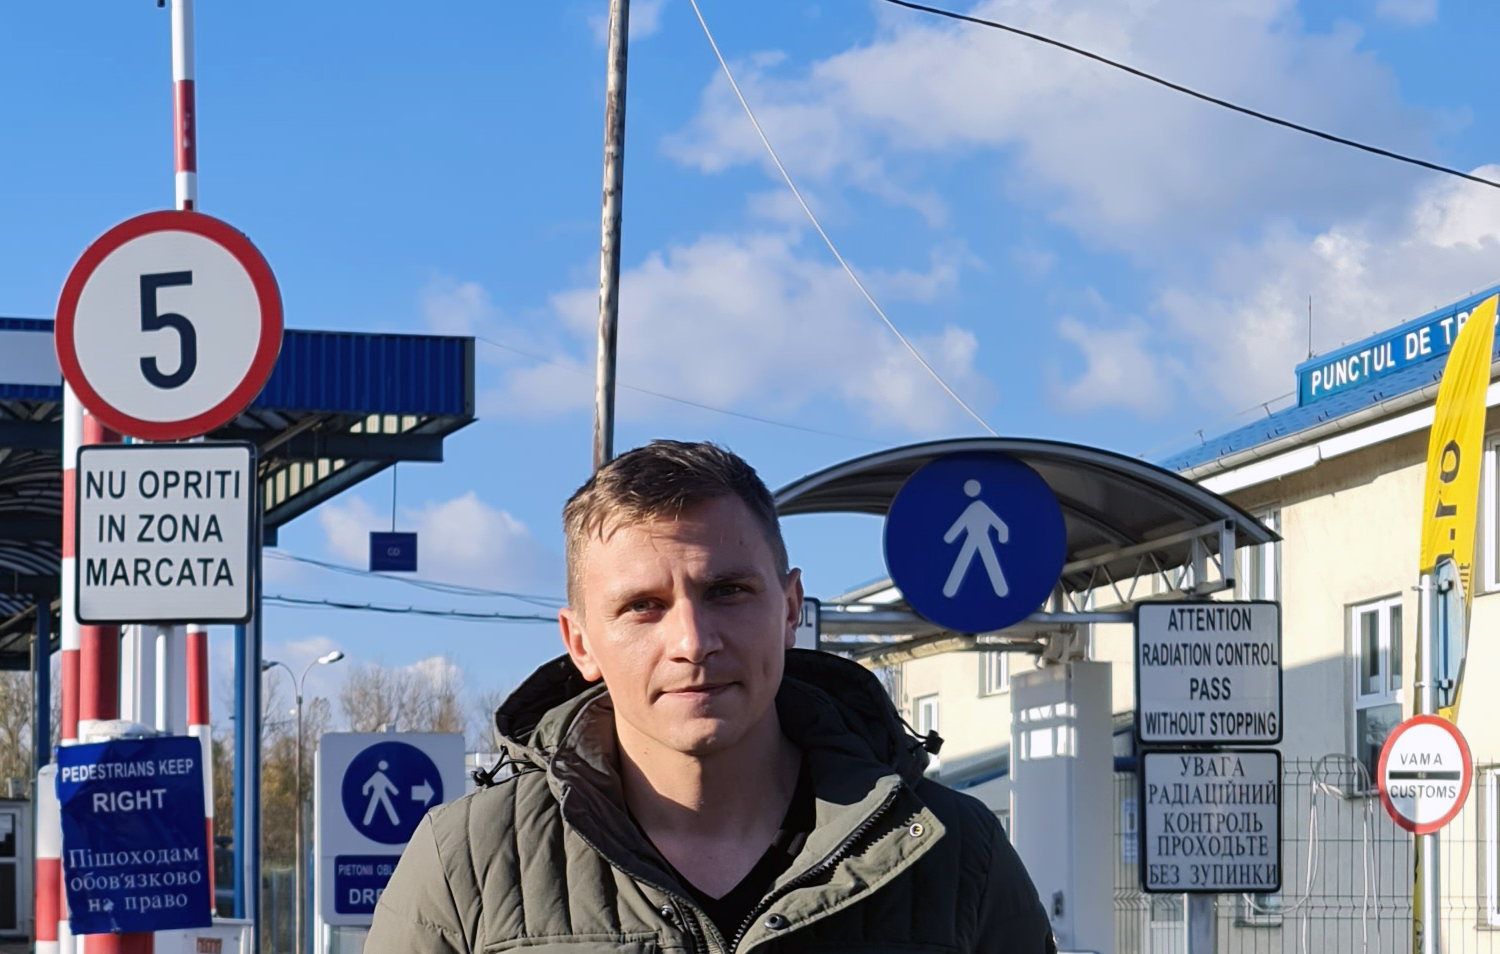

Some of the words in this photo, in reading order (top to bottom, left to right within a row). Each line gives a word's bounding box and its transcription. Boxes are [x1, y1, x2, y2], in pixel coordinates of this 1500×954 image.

[139, 270, 198, 390] 5
[1311, 341, 1396, 396] PUNCTUL
[1405, 326, 1432, 361] DE
[86, 471, 126, 499] NU
[138, 470, 240, 499] OPRITI
[99, 514, 126, 543] IN
[137, 514, 224, 543] ZONA
[86, 558, 234, 587] MARCATA
[1168, 608, 1252, 631] ATTENTION
[1142, 643, 1211, 666] RADIATION
[1216, 643, 1278, 666] CONTROL
[1189, 677, 1231, 700] PASS
[1145, 711, 1206, 735] WITHOUT
[1210, 711, 1277, 736] STOPPING
[62, 760, 155, 783] PEDESTRIANS
[159, 758, 194, 775] KEEP
[1180, 756, 1245, 777] УВАГА
[1400, 752, 1443, 766] VAMA
[92, 788, 167, 813] RIGHT
[1148, 780, 1277, 808] РАДІАЦІЙНИЙ
[1390, 784, 1456, 799] CUSTOMS
[1163, 812, 1263, 834] КОНТРОЛЬ
[68, 847, 200, 869] Пішоходам
[1157, 836, 1269, 861] ПРОХОДЬТЕ
[1149, 864, 1180, 885] БЕЗ
[1190, 864, 1277, 888] ЗУПИНКИ
[124, 893, 188, 914] право
